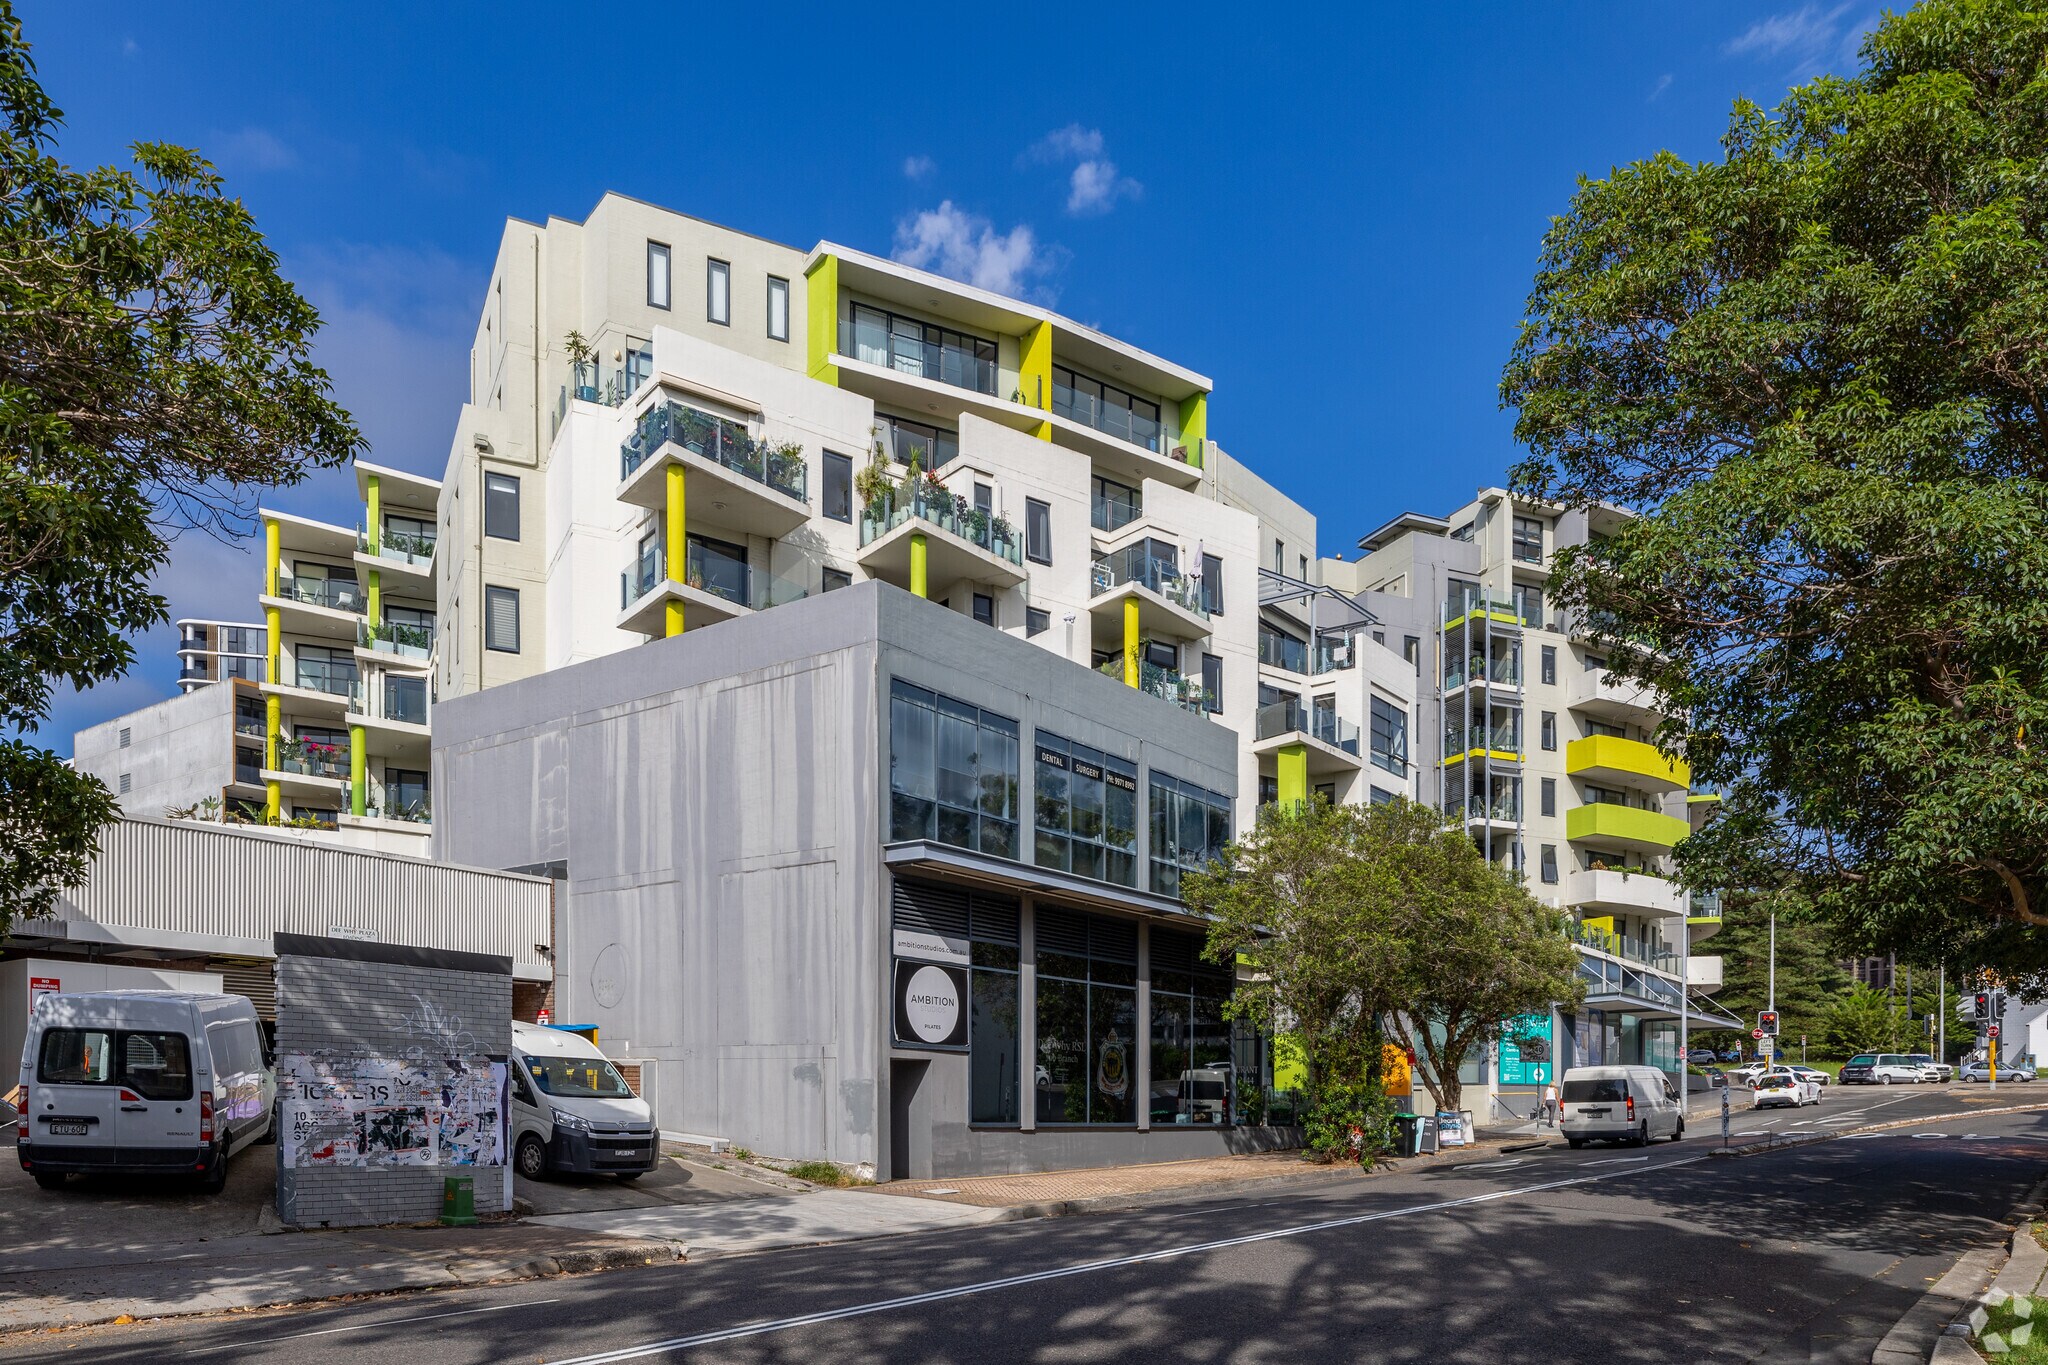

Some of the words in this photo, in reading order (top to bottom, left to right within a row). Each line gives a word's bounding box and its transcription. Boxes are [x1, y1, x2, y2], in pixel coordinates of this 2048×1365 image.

[1042, 752, 1063, 767] DENTAL
[1076, 764, 1099, 779] SURGERY
[897, 940, 967, 956] ambitionstudios.com.au
[910, 994, 955, 1007] AMBITION
[1072, 1041, 1086, 1052] RSL
[294, 1111, 307, 1121] 10
